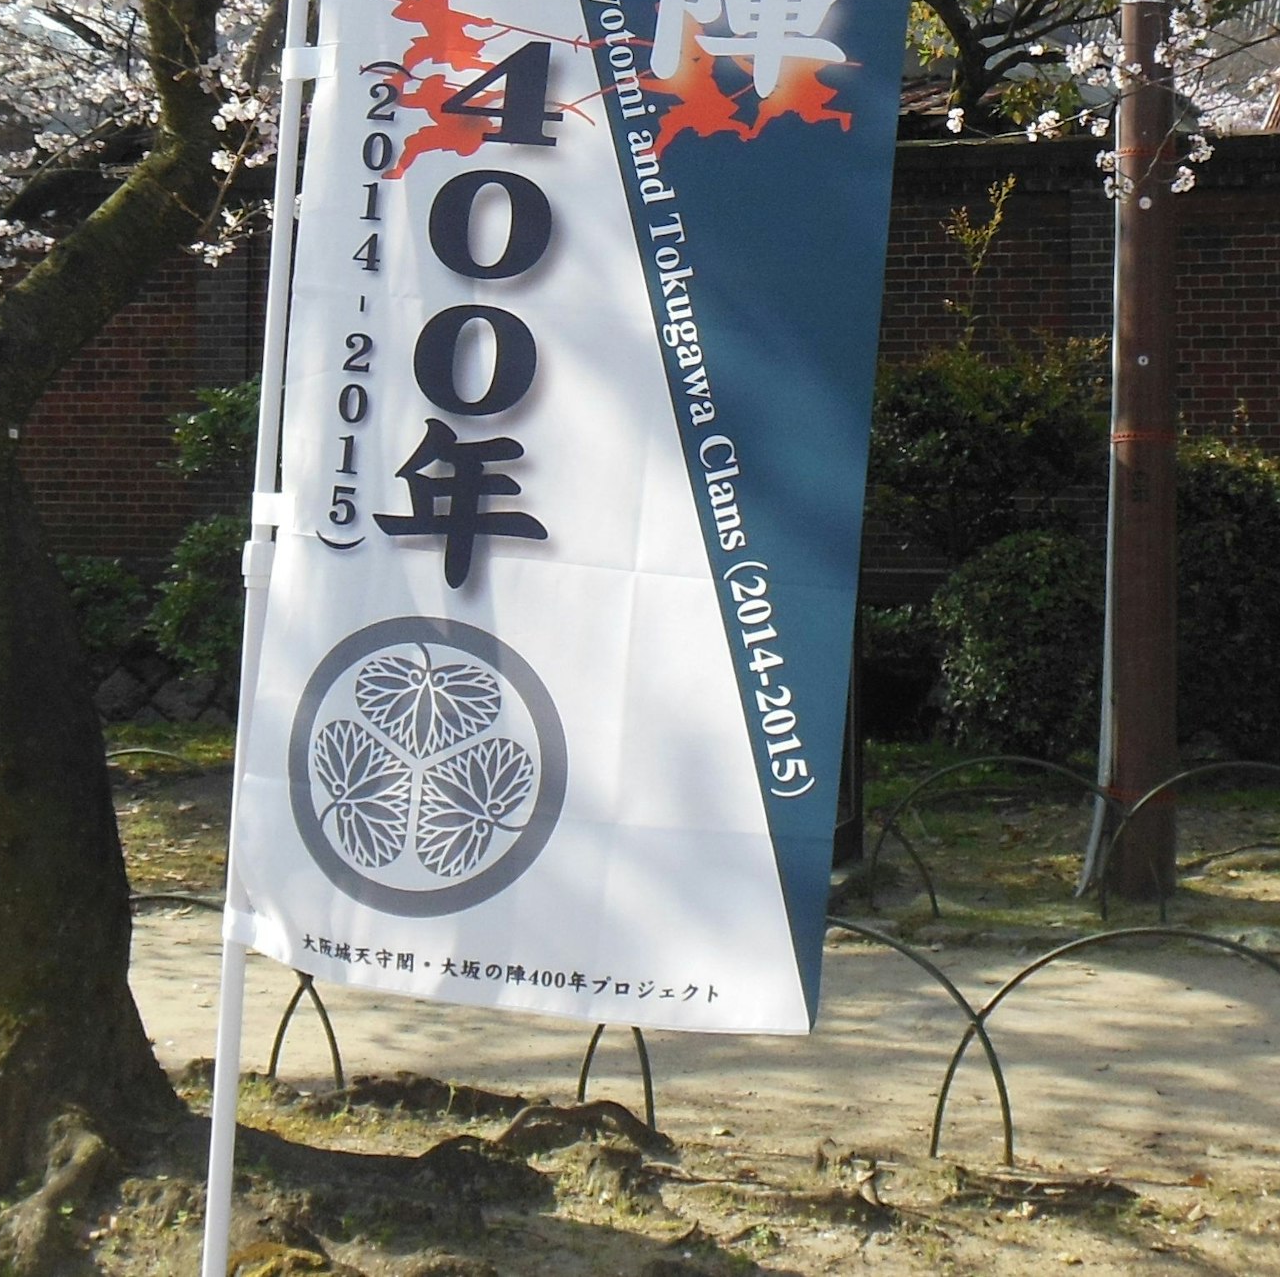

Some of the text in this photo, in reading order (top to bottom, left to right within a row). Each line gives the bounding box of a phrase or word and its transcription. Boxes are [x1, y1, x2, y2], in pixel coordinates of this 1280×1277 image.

[627, 129, 676, 205] and
[316, 60, 413, 550] (2014-2015)
[372, 41, 565, 589] 400年
[649, 212, 716, 426] Tokugawa
[698, 434, 747, 551] Clans
[723, 560, 815, 797] (2014-2015)
